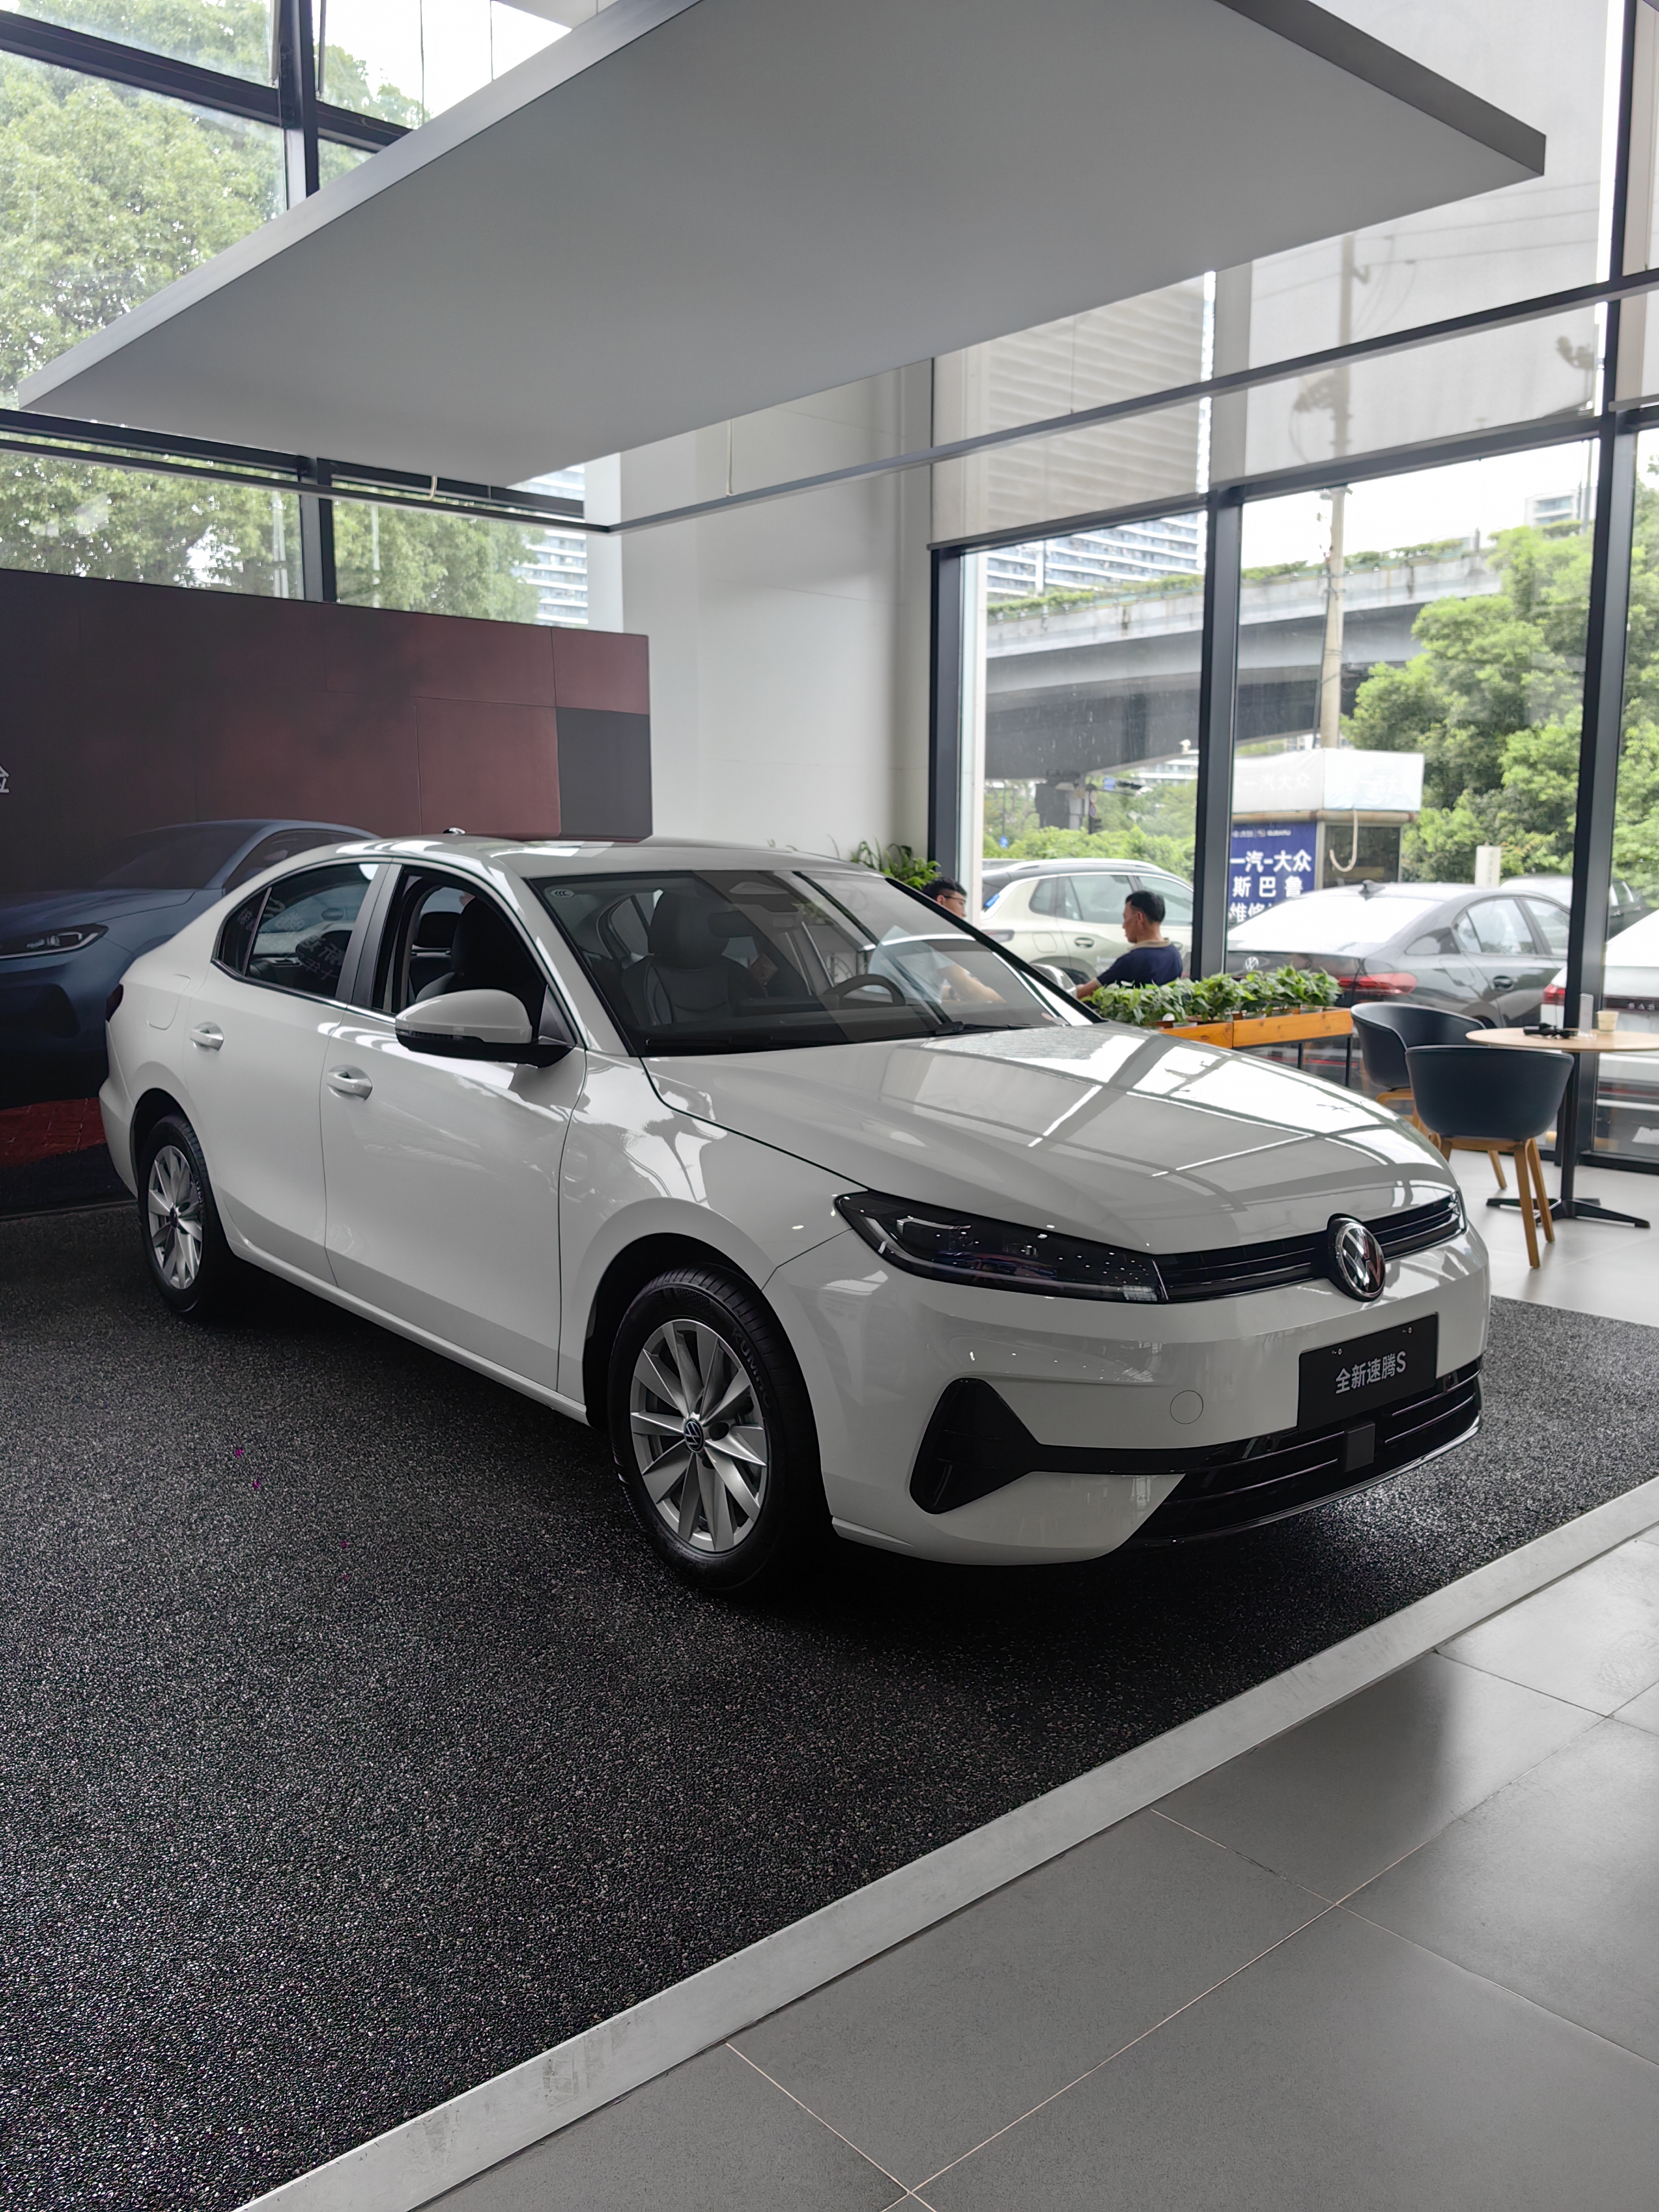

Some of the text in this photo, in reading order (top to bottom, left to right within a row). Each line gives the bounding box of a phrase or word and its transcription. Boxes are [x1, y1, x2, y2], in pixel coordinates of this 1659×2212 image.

[1230, 849, 1312, 873] 一汽-大众
[1233, 876, 1303, 898] 斯巴鲁
[1229, 902, 1272, 923] 维修
[1335, 1351, 1406, 1394] 全新速腾S
